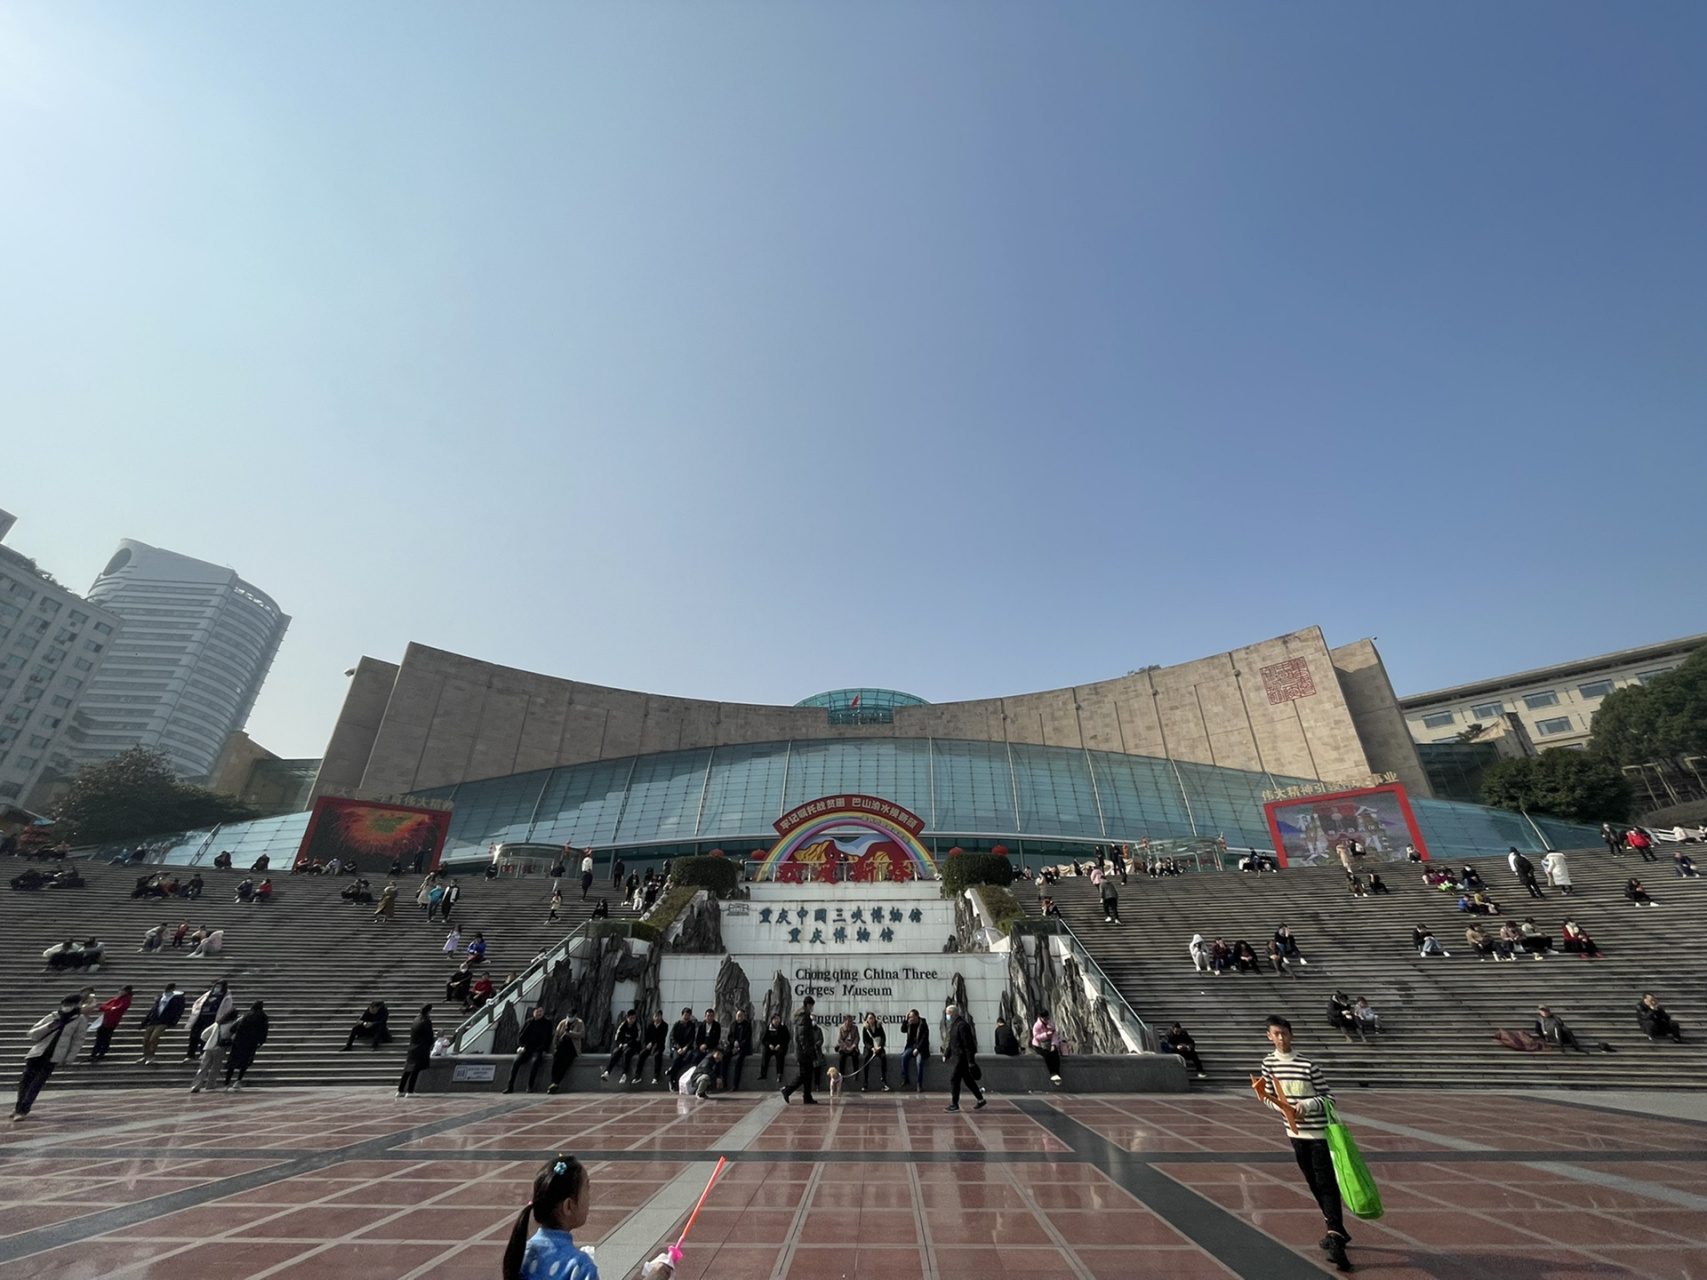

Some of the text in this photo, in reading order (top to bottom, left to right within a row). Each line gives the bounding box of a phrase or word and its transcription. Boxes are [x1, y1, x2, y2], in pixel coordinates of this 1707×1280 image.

[1262, 771, 1397, 801] 伟大精神引领事业
[780, 798, 845, 830] 牢记嘱托战贫困
[851, 797, 919, 830] 巴山渝水换新颜
[795, 968, 938, 982] Chongqing China Three
[794, 984, 892, 998] Gorges Museum
[859, 1012, 906, 1024] Mseum
